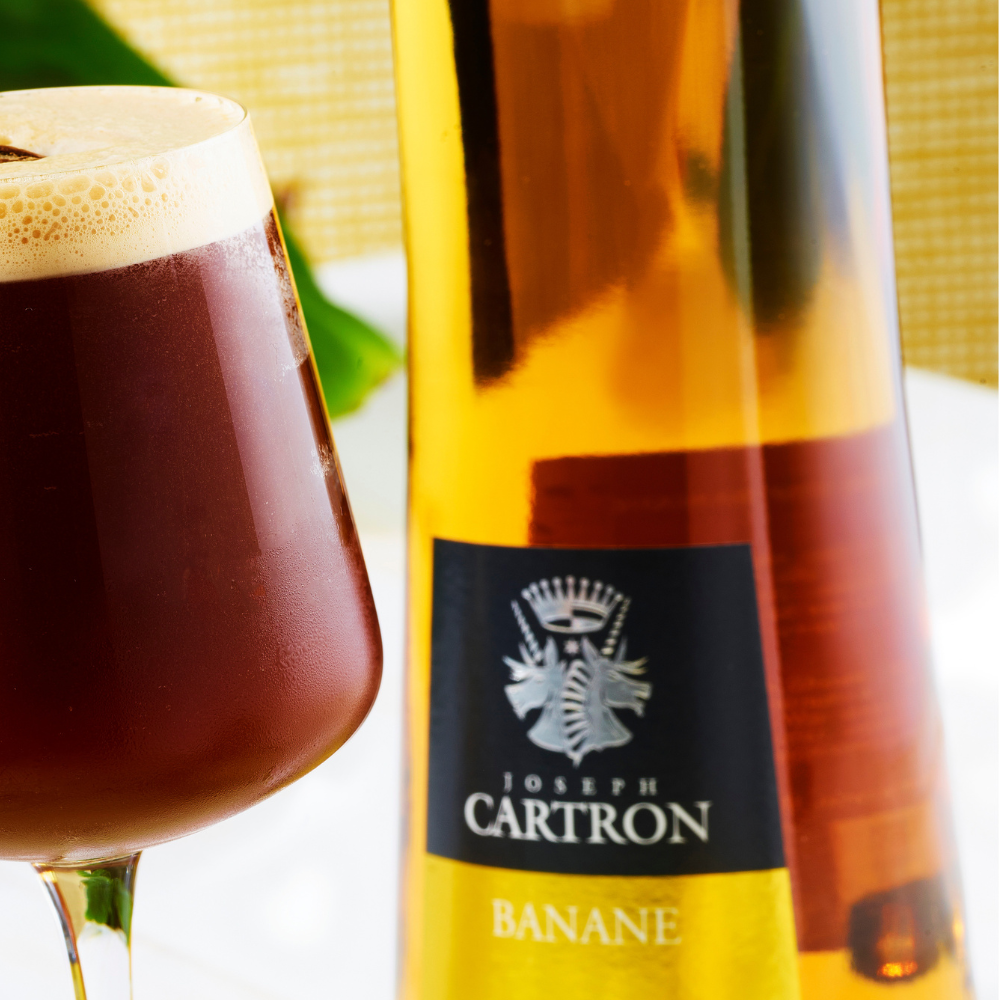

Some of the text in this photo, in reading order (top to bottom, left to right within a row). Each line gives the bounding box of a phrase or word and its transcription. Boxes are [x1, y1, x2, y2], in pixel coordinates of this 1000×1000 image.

[503, 771, 658, 796] JOSEPH
[464, 792, 712, 845] CARTRON
[491, 898, 682, 946] BANANE
